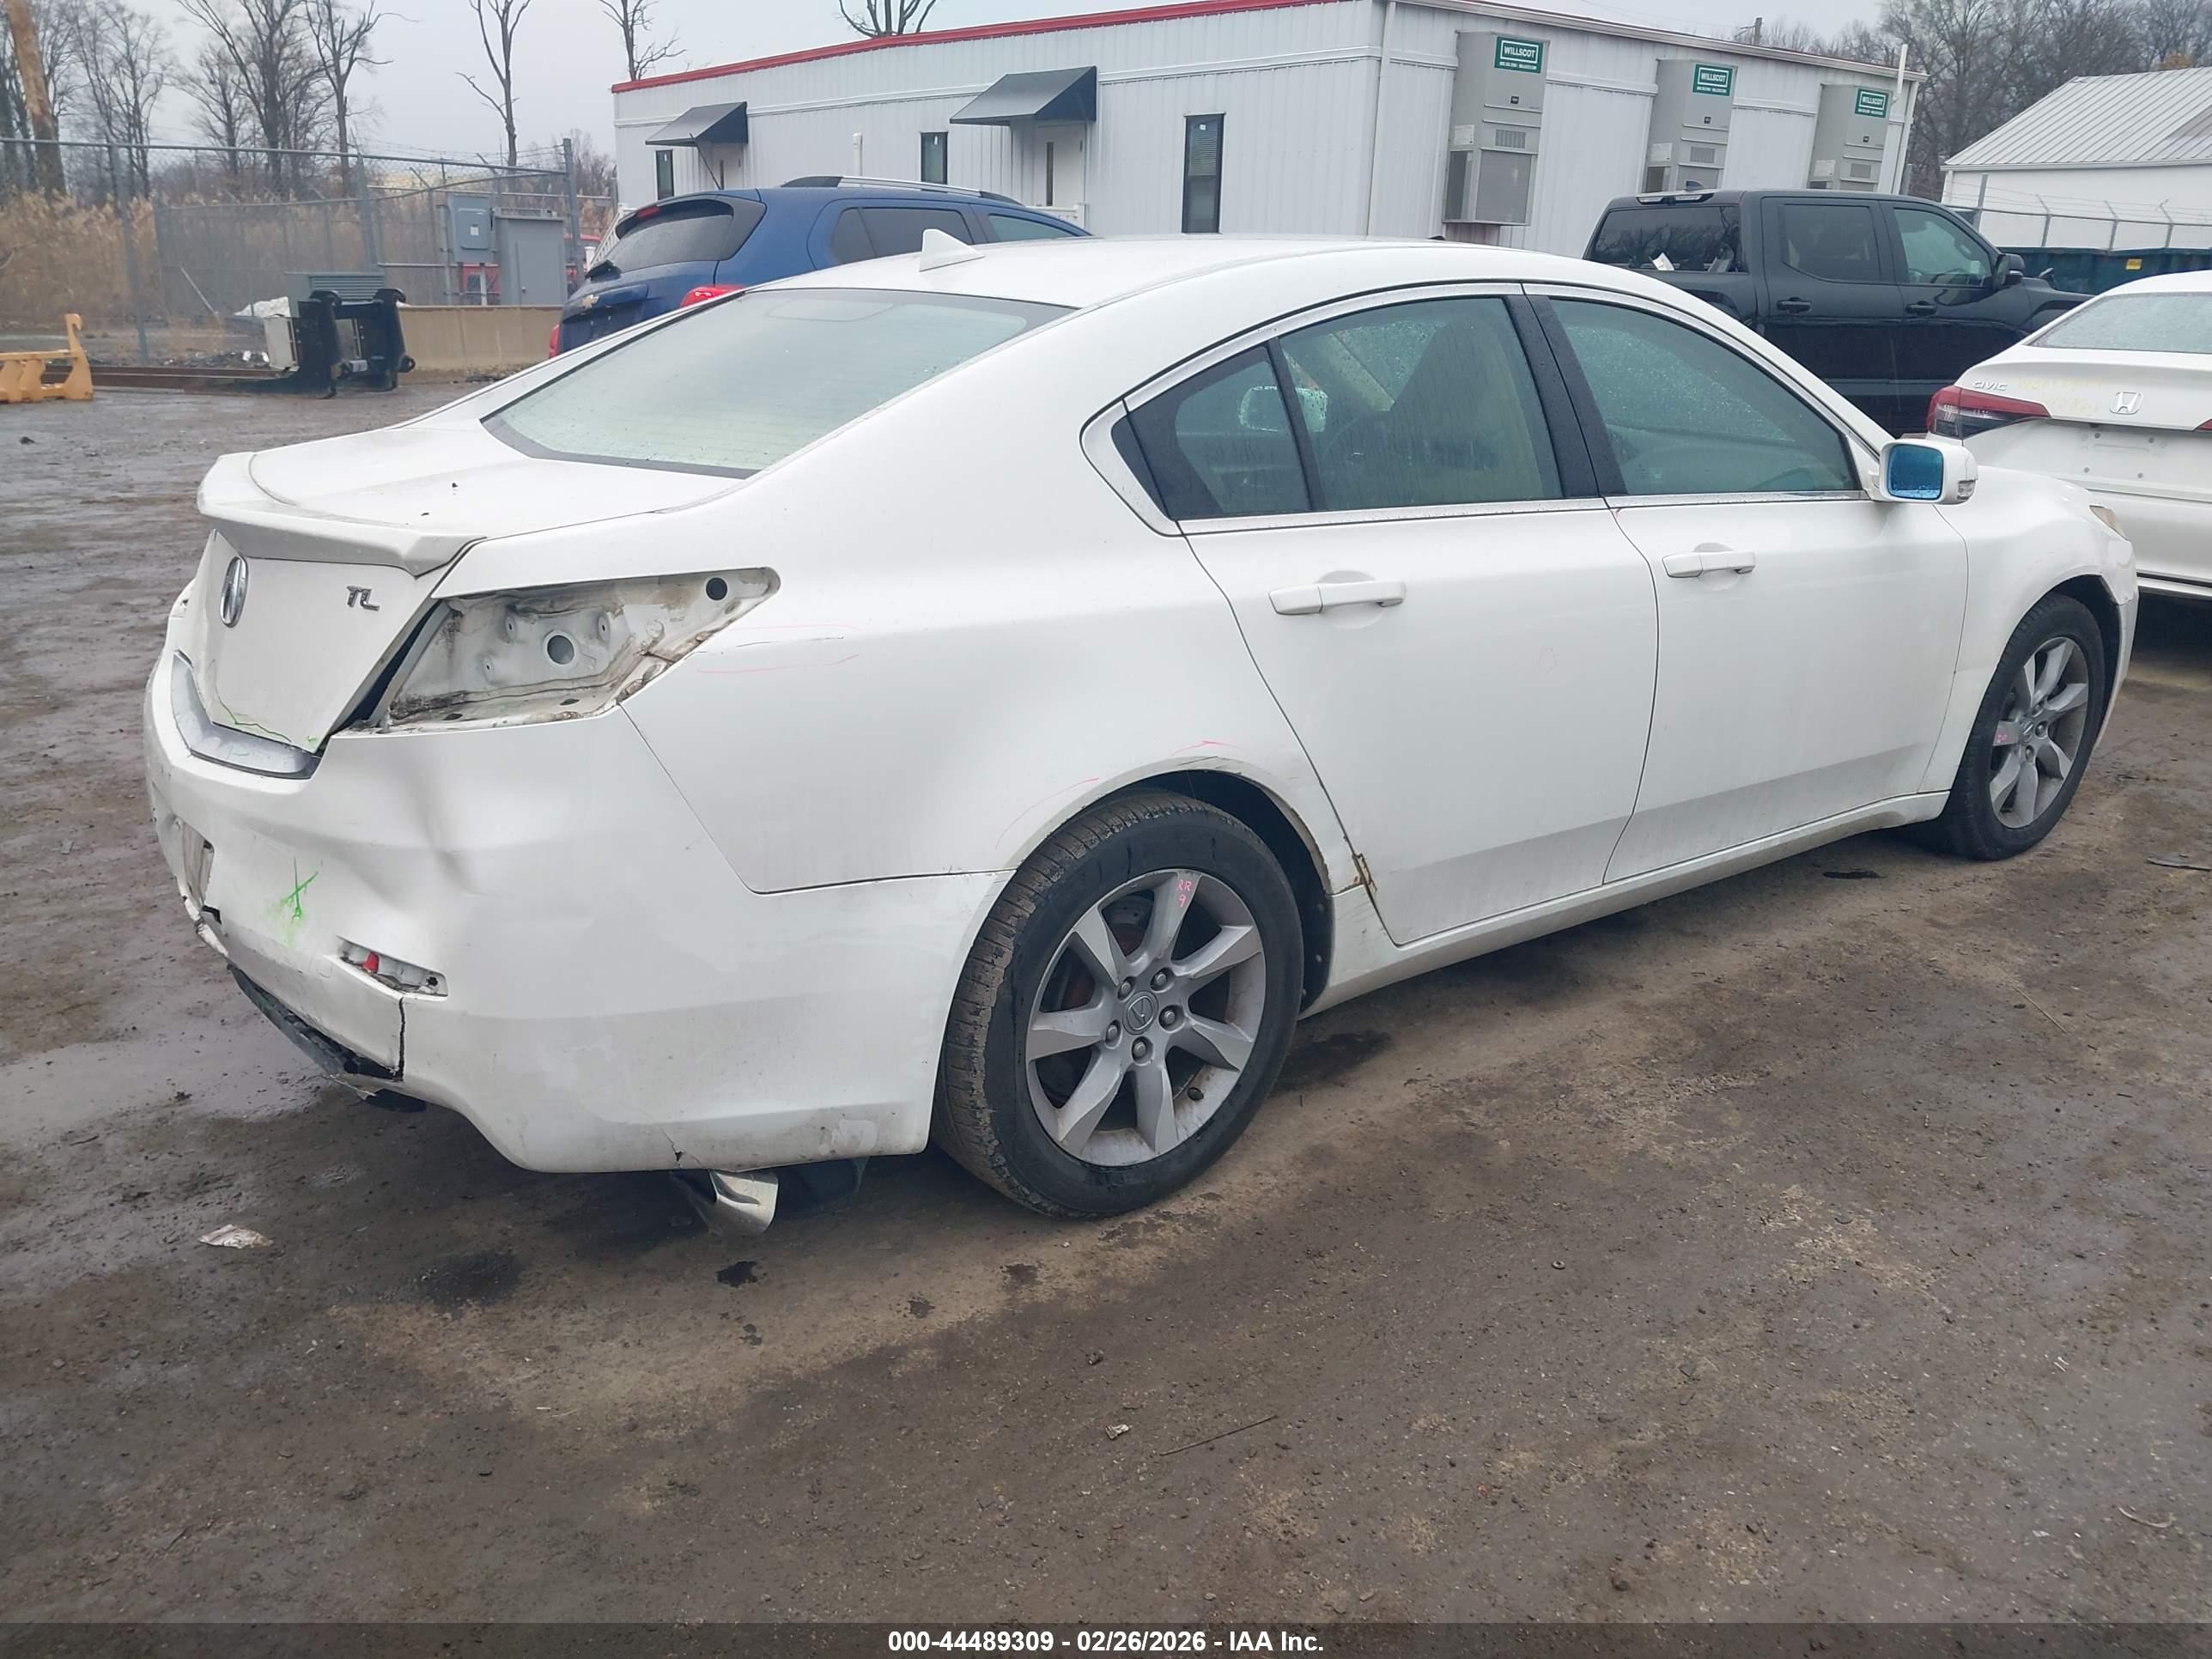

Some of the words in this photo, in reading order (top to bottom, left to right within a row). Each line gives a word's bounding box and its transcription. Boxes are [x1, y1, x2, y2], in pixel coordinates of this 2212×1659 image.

[1504, 46, 1536, 58] WILLSCOT
[1701, 73, 1726, 82] WILLSCOT
[1973, 381, 2008, 392] CIVIC
[346, 585, 380, 611] TL
